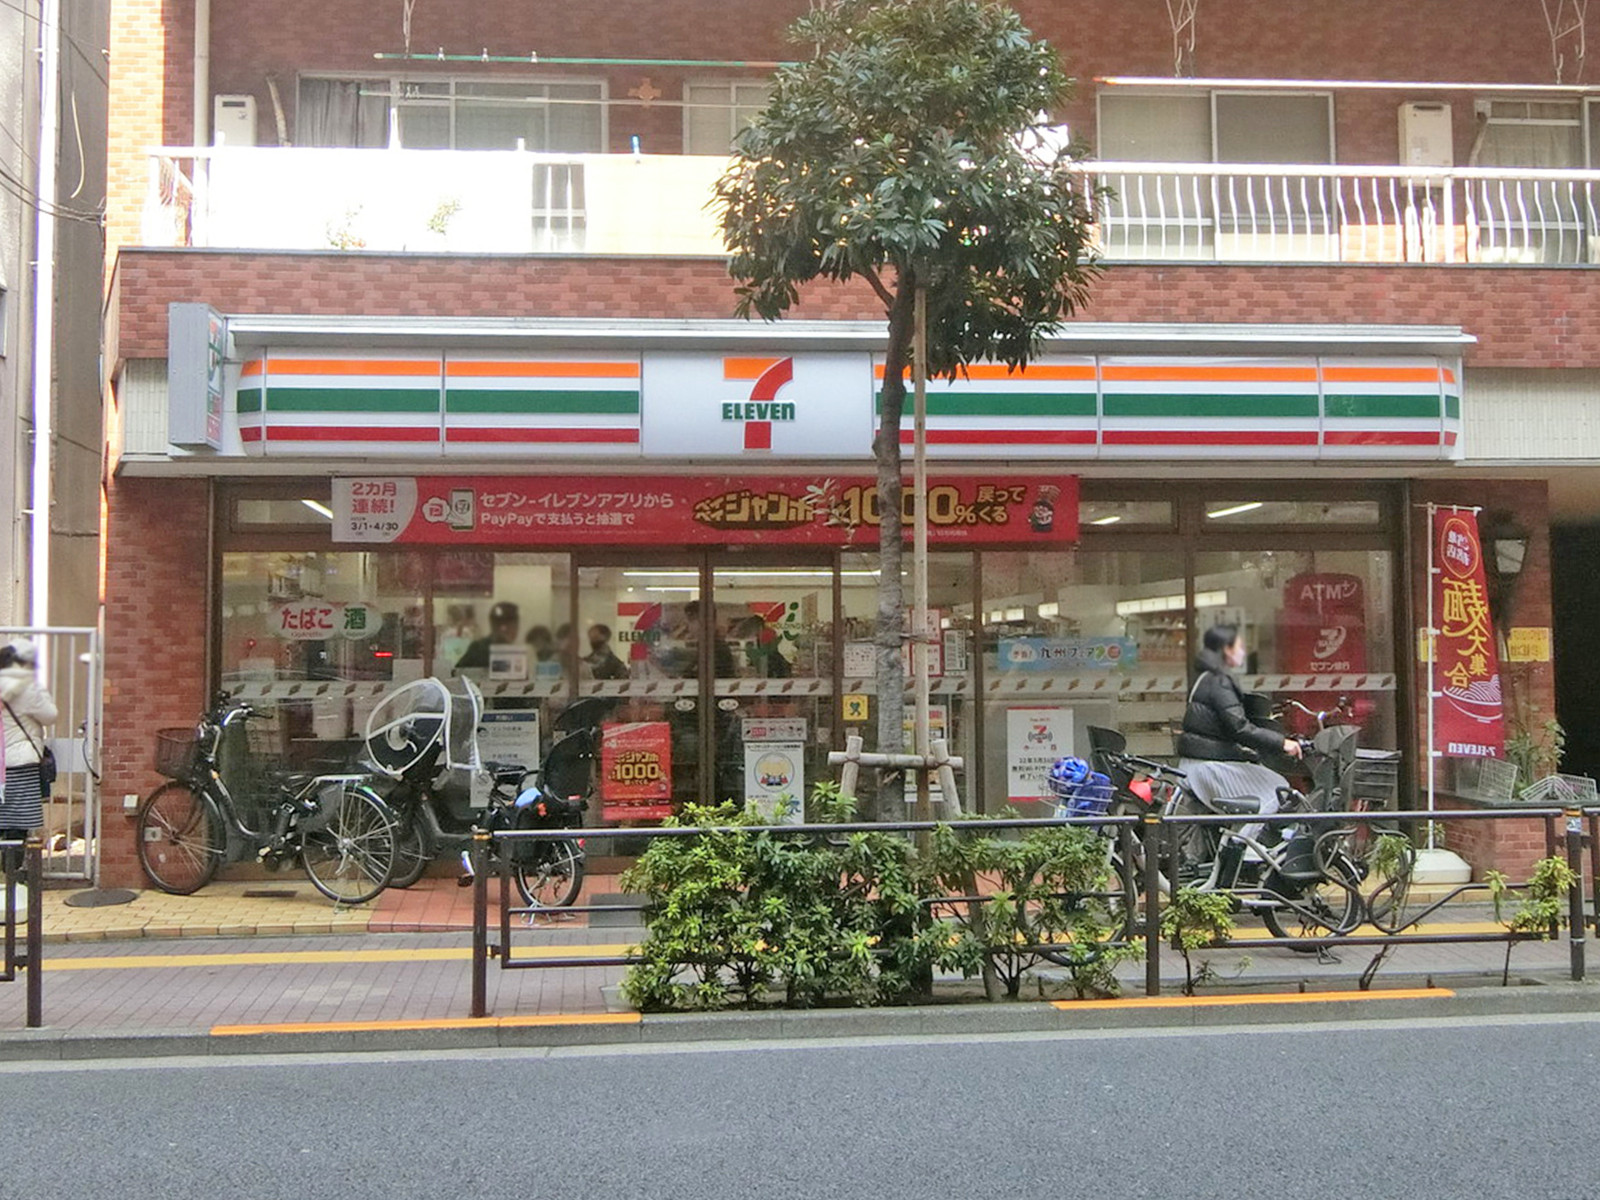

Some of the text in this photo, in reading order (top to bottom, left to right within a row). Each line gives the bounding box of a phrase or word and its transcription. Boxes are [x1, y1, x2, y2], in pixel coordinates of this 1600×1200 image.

[723, 356, 793, 449] 7
[352, 498, 394, 514] 連続!
[480, 511, 636, 527] PayPayで支払うと抽選で
[281, 606, 367, 630] たばこ 酒
